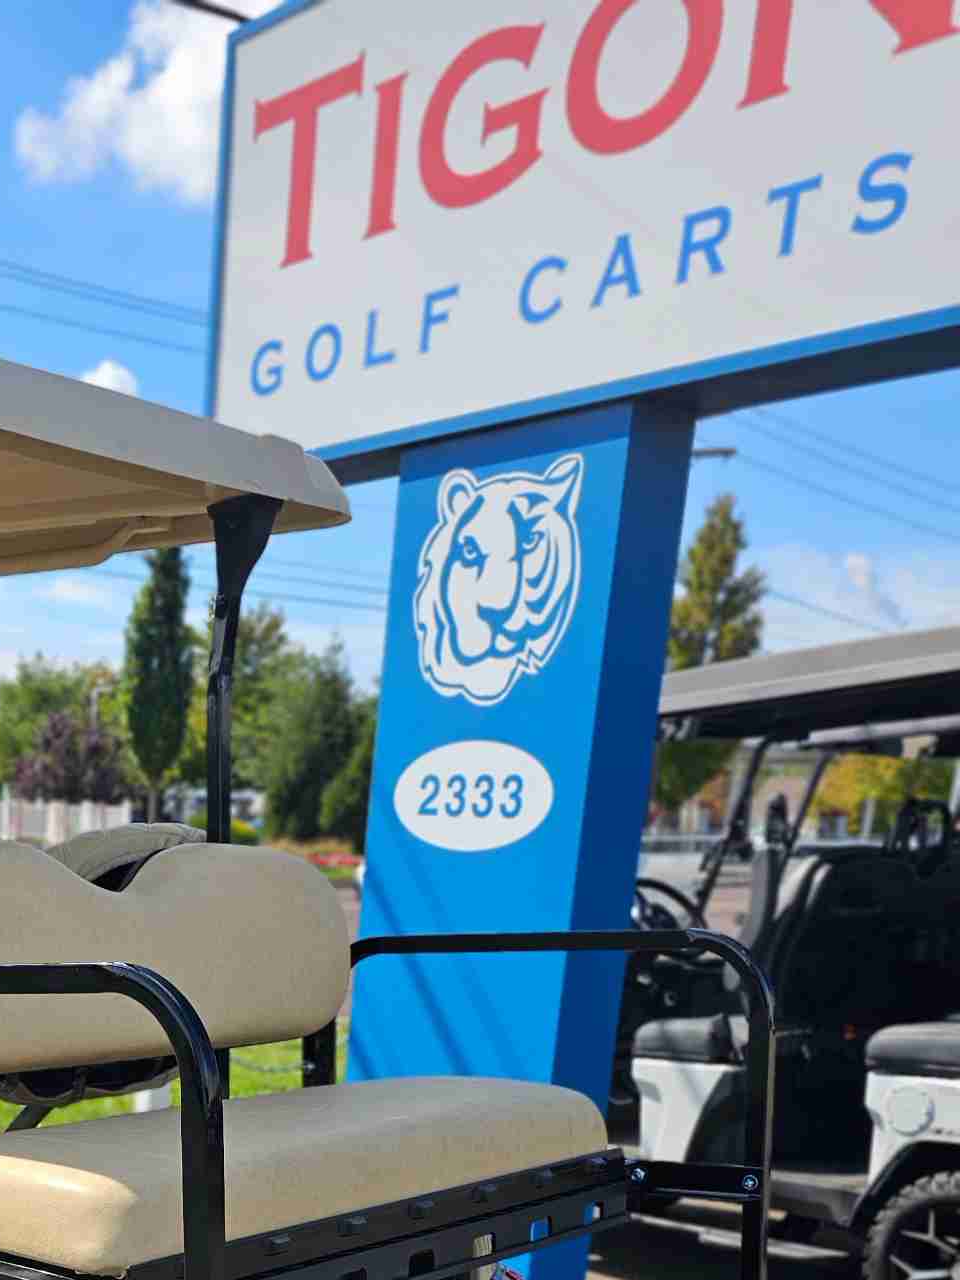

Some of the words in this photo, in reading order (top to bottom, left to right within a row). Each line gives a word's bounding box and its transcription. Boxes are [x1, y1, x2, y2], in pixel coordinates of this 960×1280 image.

[249, 284, 460, 397] GOLF
[517, 151, 914, 325] CARTS
[417, 773, 525, 819] 2333
